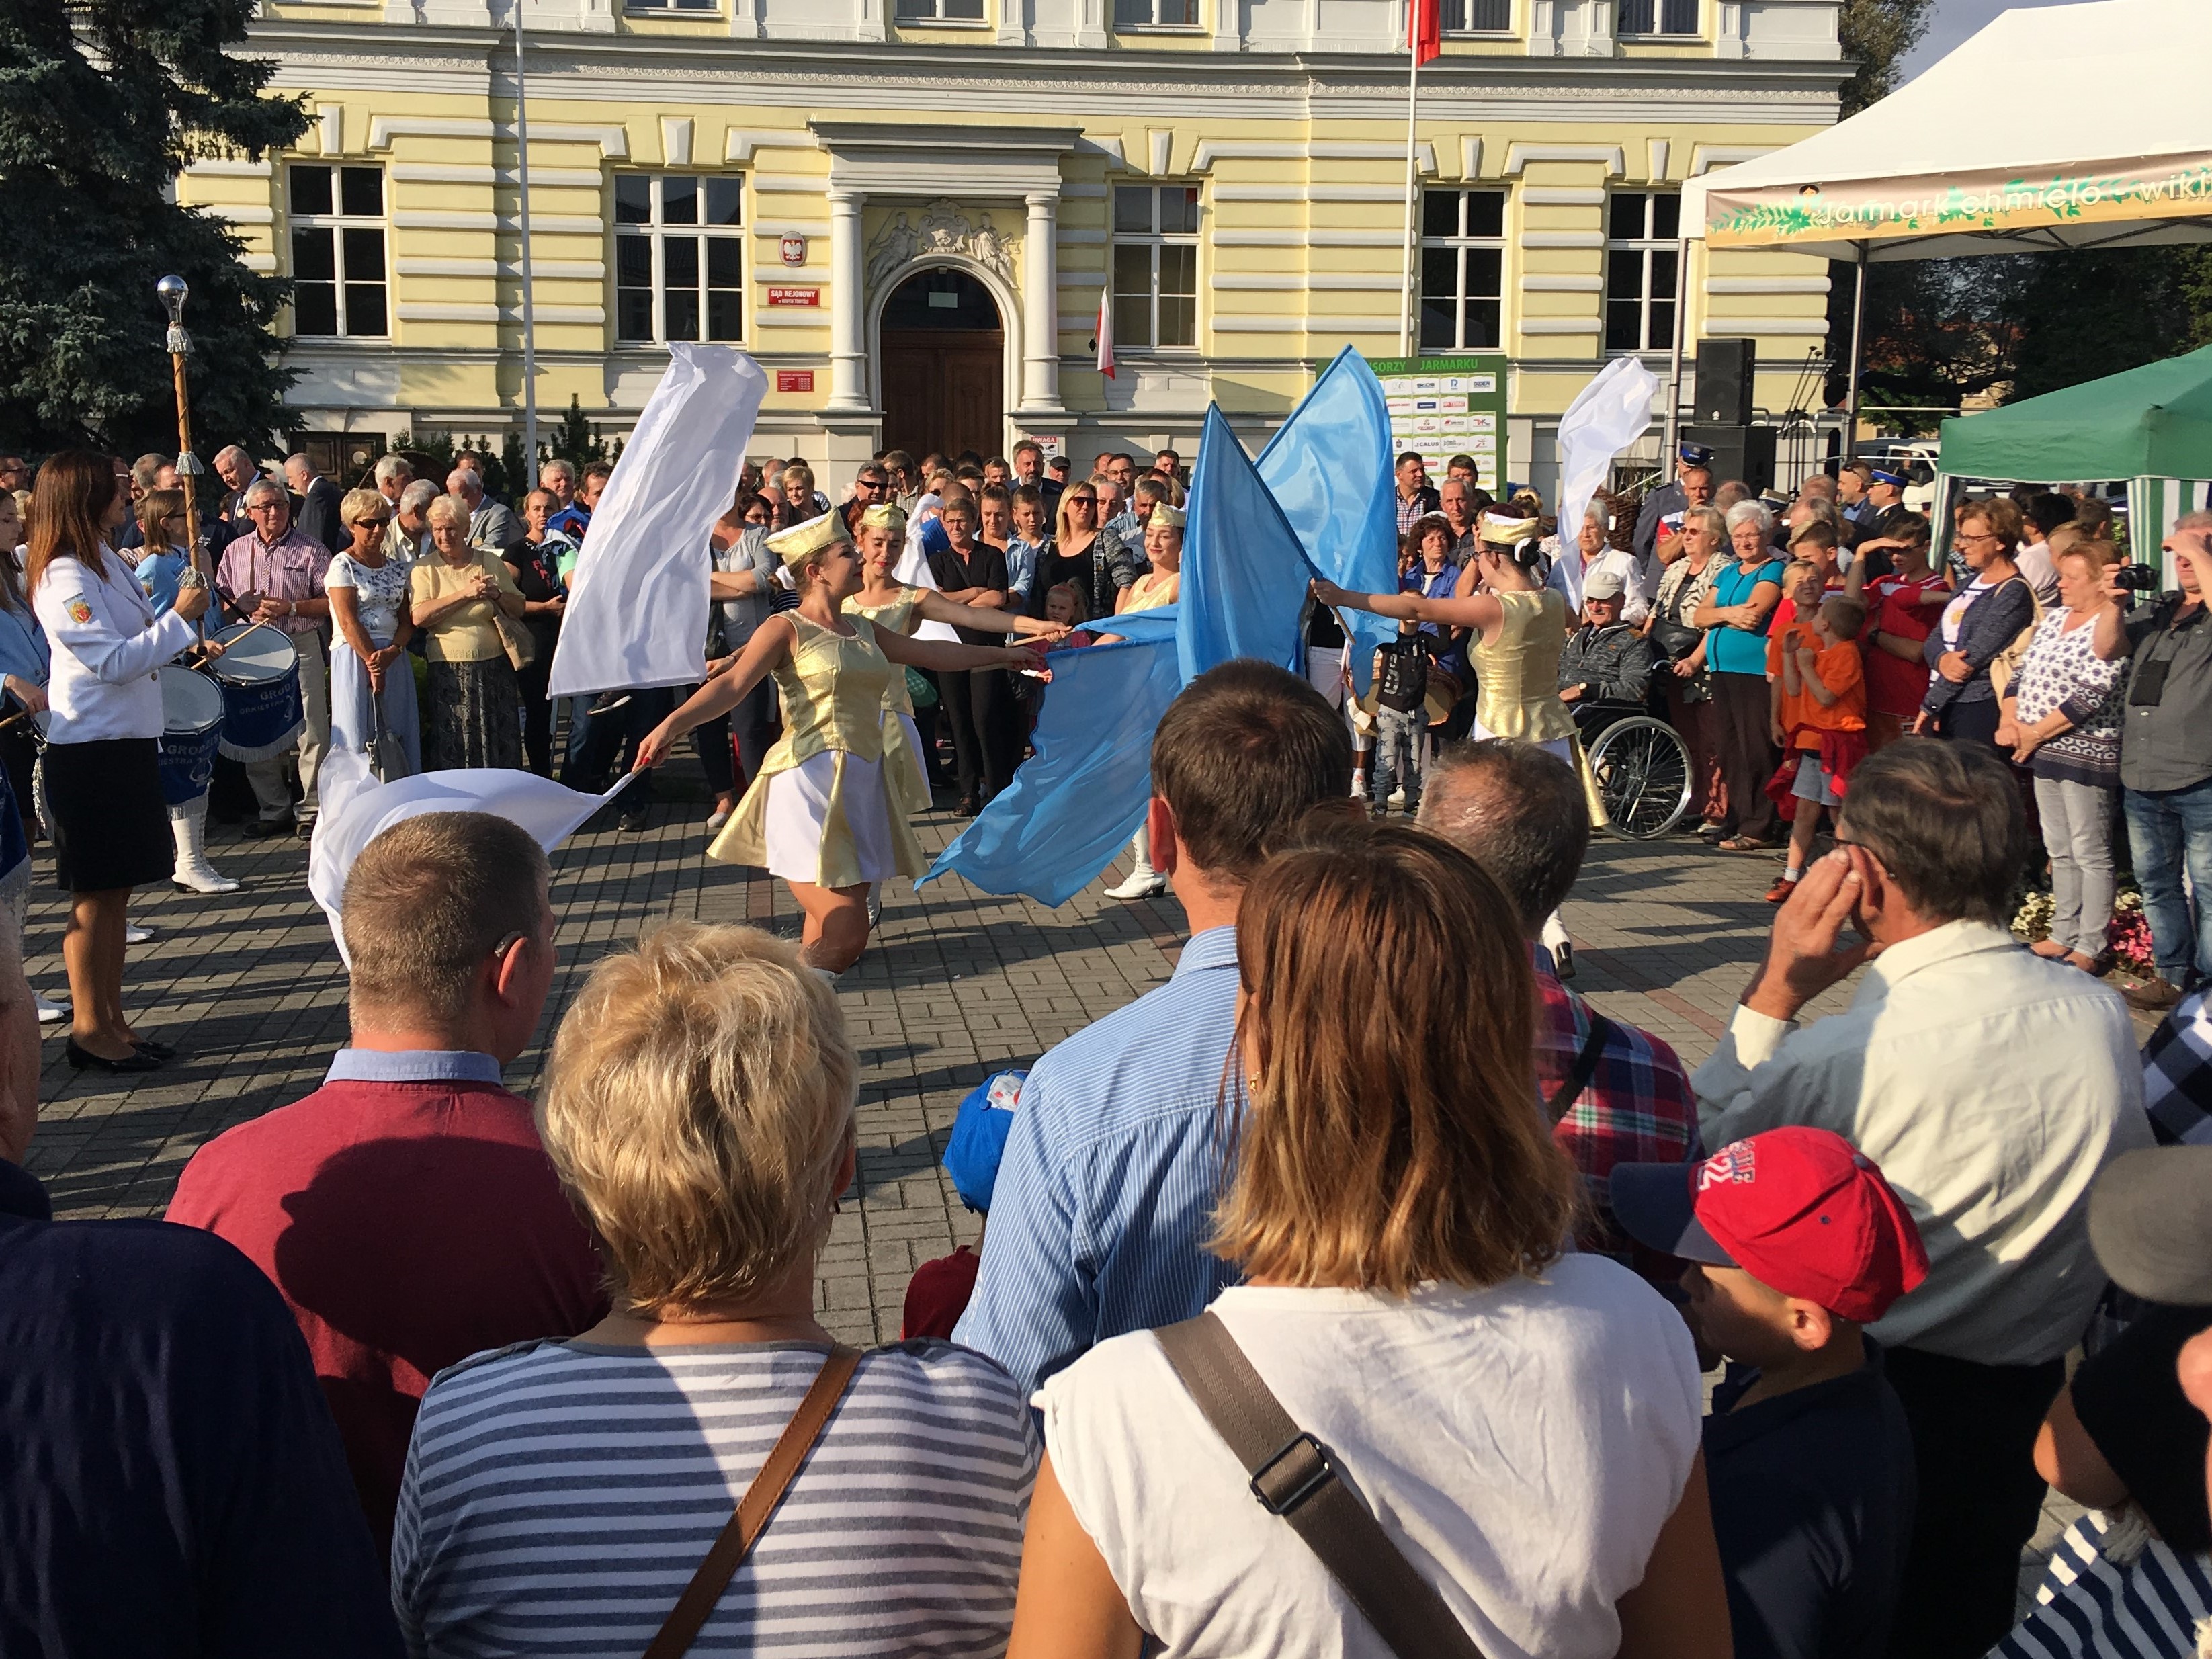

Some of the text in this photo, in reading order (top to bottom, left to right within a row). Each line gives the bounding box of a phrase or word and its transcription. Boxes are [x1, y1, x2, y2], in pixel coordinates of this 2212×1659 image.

[1819, 192, 1949, 225] Jarmark
[1960, 182, 2102, 215] chmielo
[771, 290, 783, 298] SĄD
[1369, 358, 1478, 372] SORZY JARMARKU
